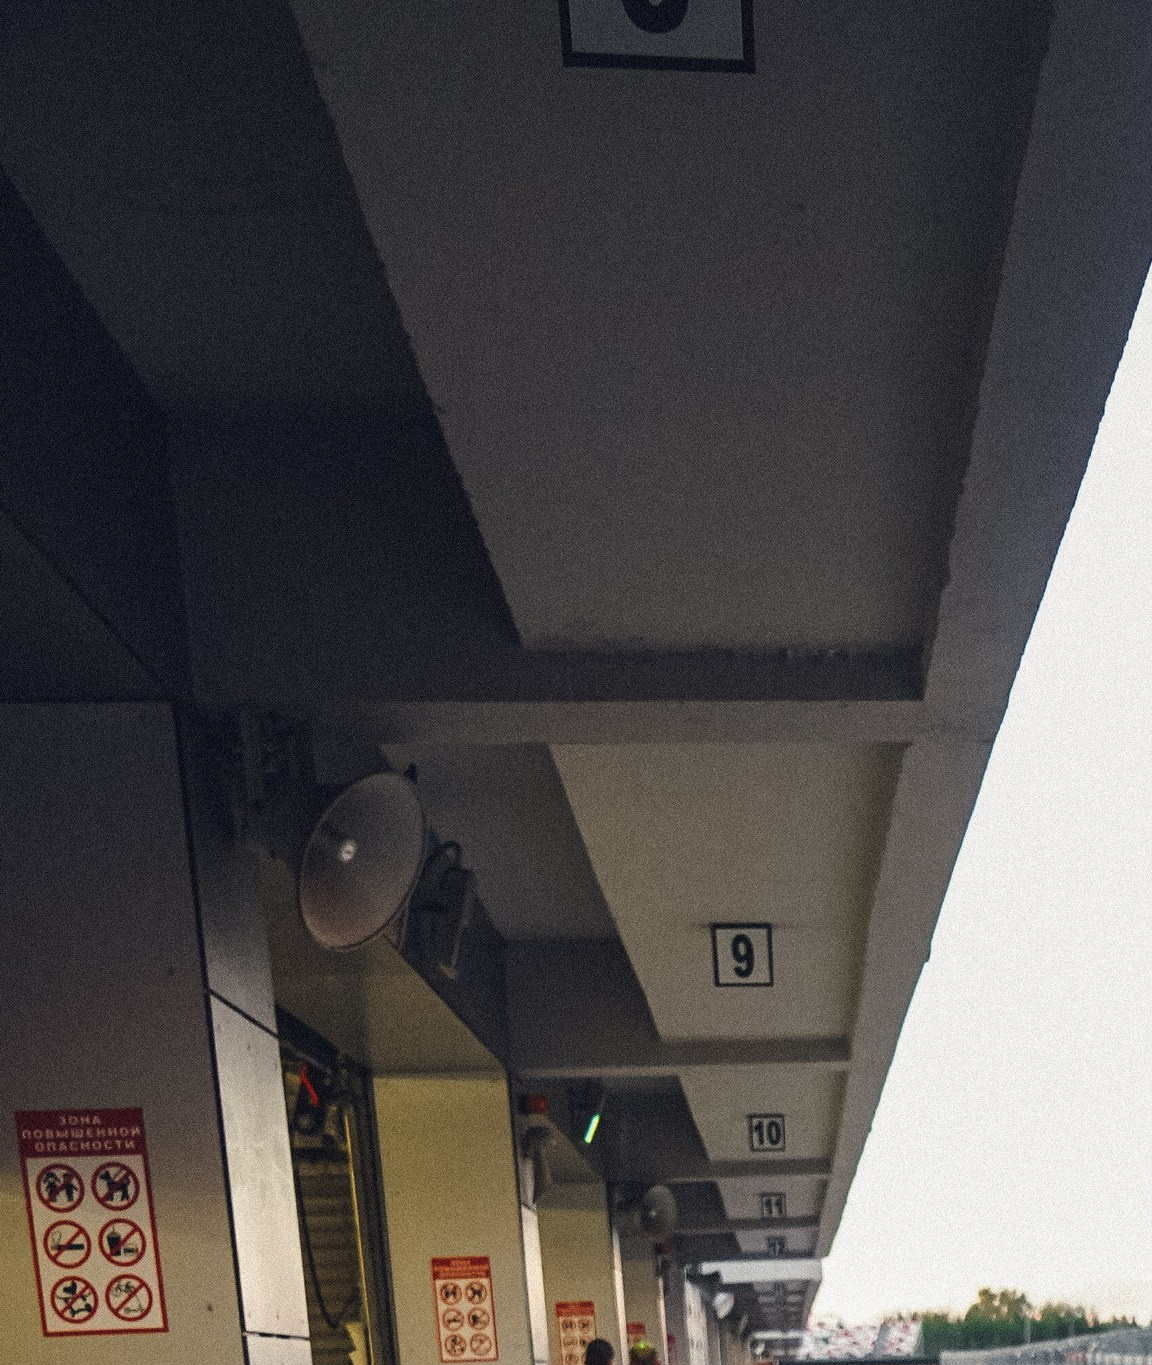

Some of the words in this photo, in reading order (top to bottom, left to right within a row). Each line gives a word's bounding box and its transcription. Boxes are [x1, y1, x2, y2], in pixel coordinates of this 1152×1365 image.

[731, 934, 754, 978] 9
[60, 1115, 101, 1126] ЗОНА
[22, 1126, 140, 1139] ПОВЫШЕННОЙ
[753, 1120, 782, 1145] 10
[34, 1139, 135, 1152] ОПАСНОСТИ
[764, 1198, 783, 1215] 11
